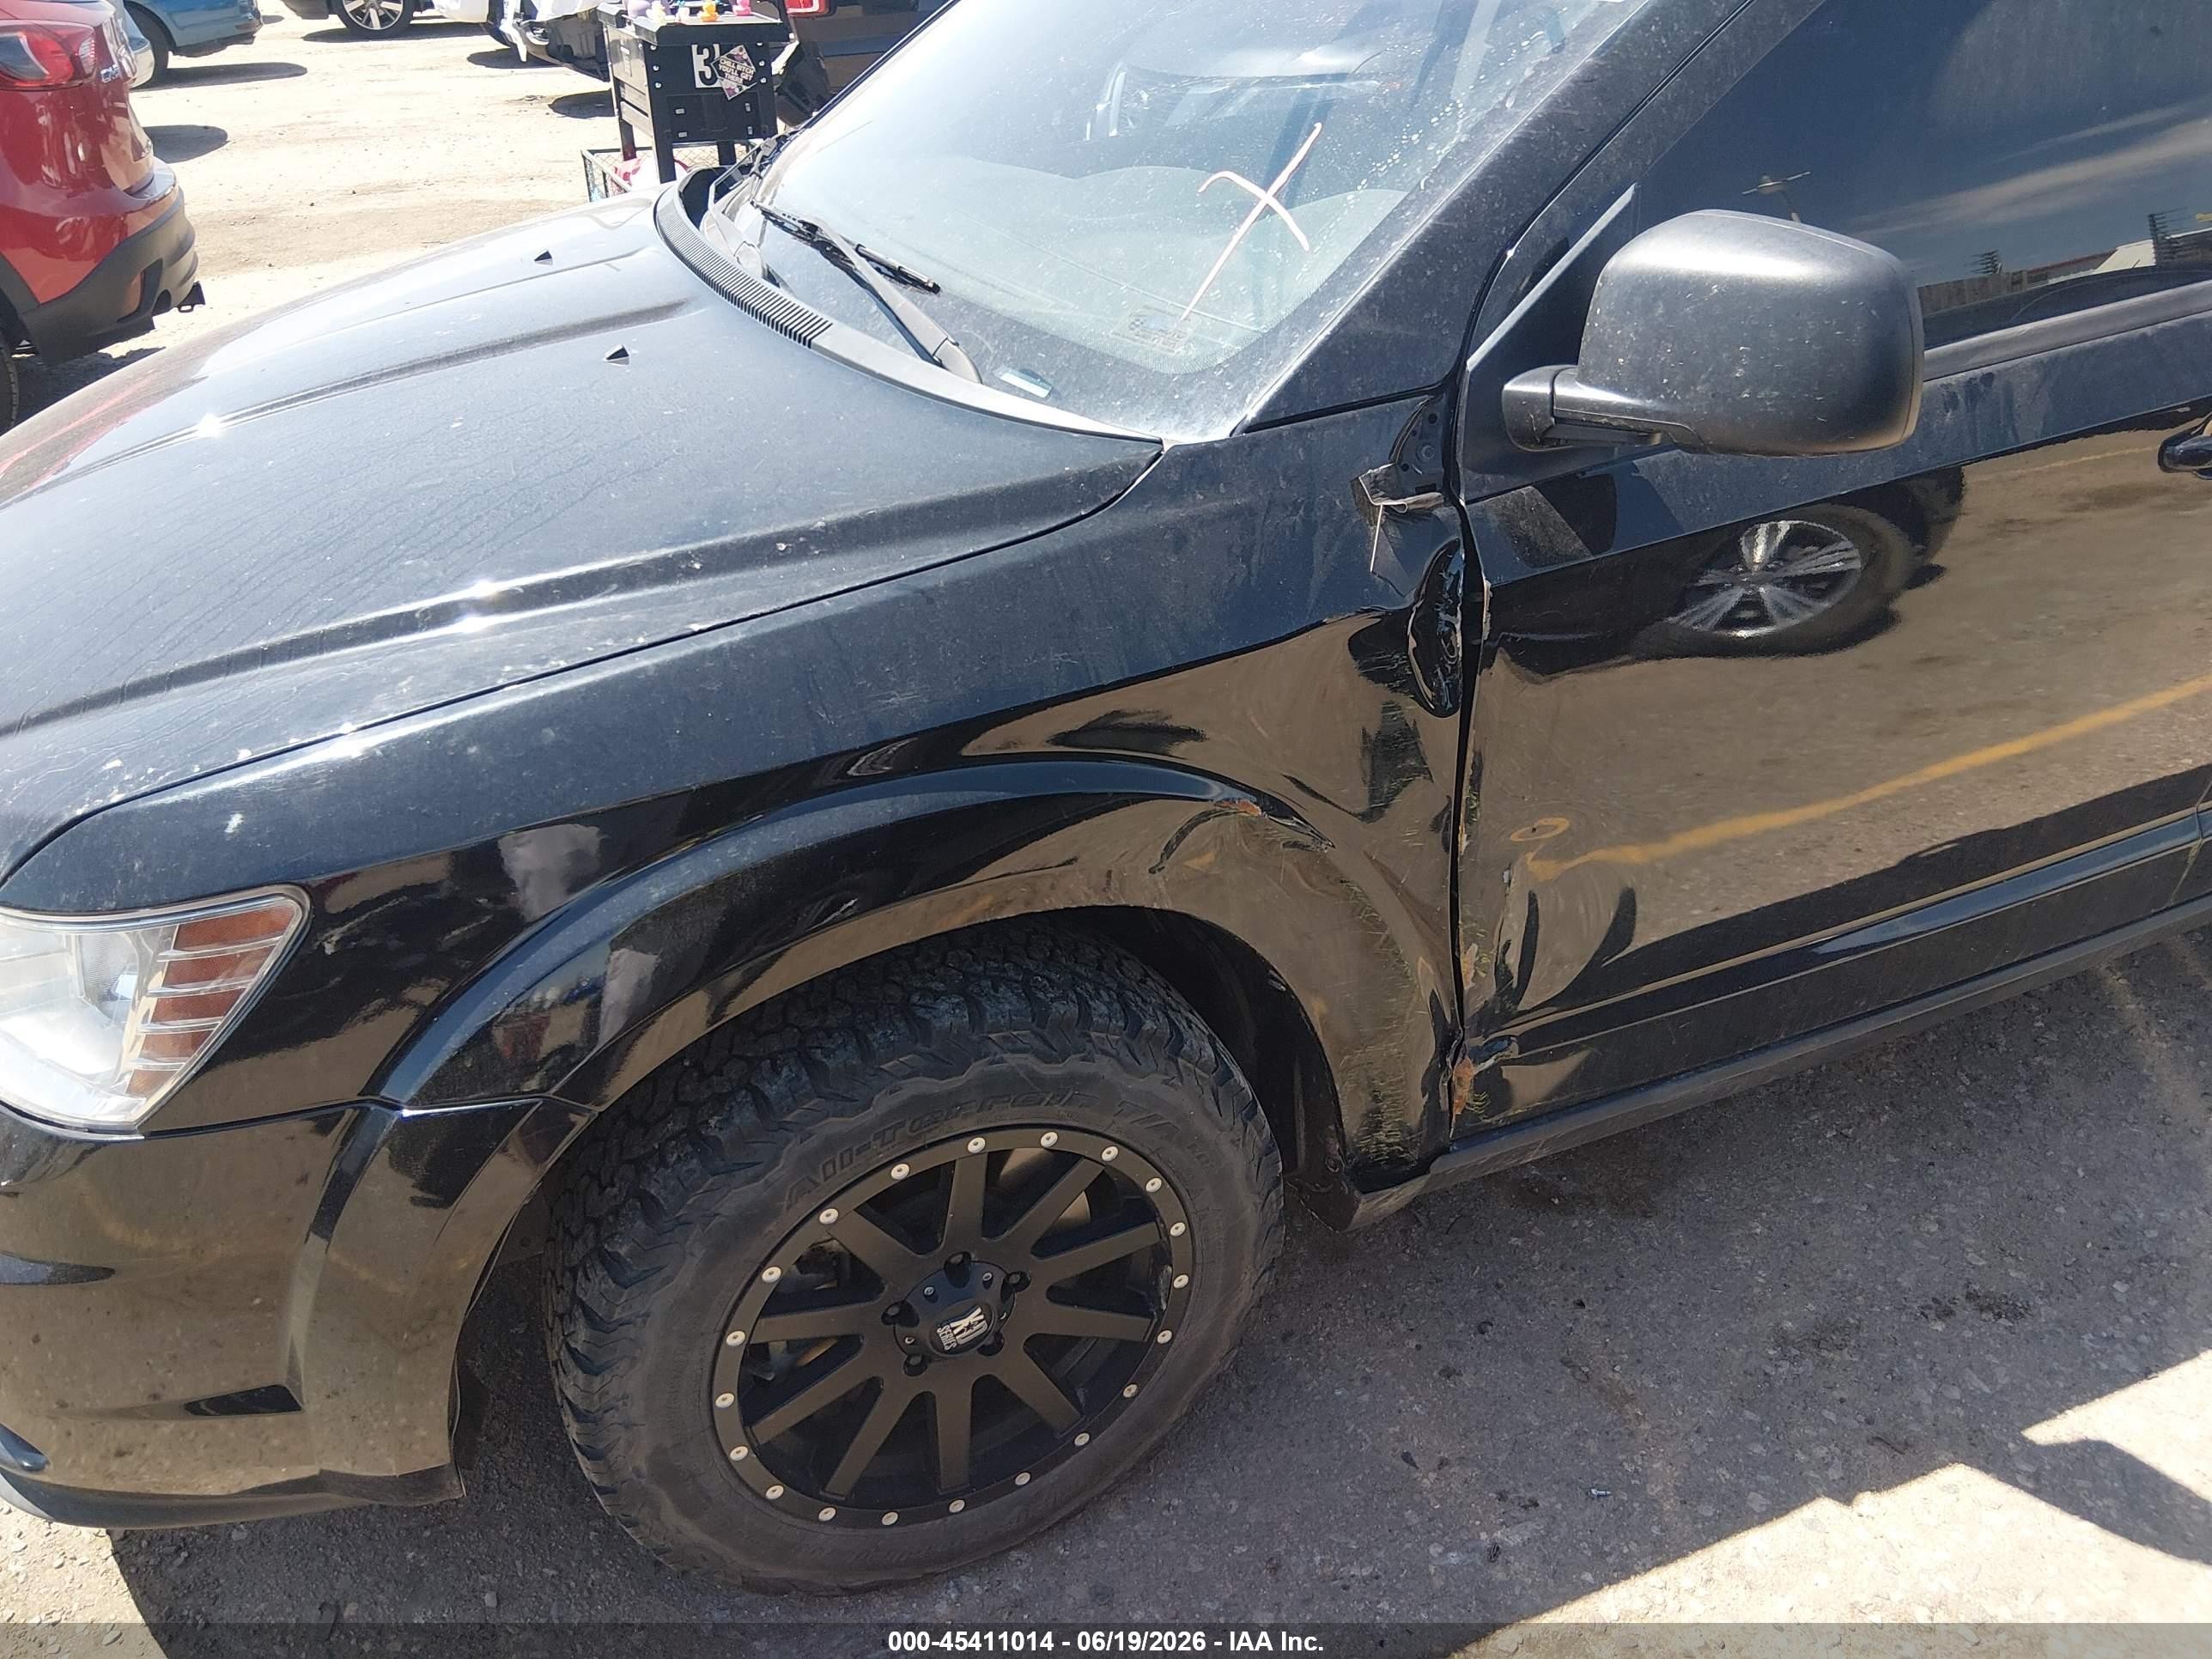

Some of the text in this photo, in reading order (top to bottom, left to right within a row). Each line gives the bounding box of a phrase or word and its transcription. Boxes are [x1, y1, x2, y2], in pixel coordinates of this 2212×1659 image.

[718, 64, 753, 82] YOU'LL GET
[720, 58, 755, 75] CHILL BITCH
[724, 73, 744, 84] THERE
[936, 1324, 957, 1351] SERIES
